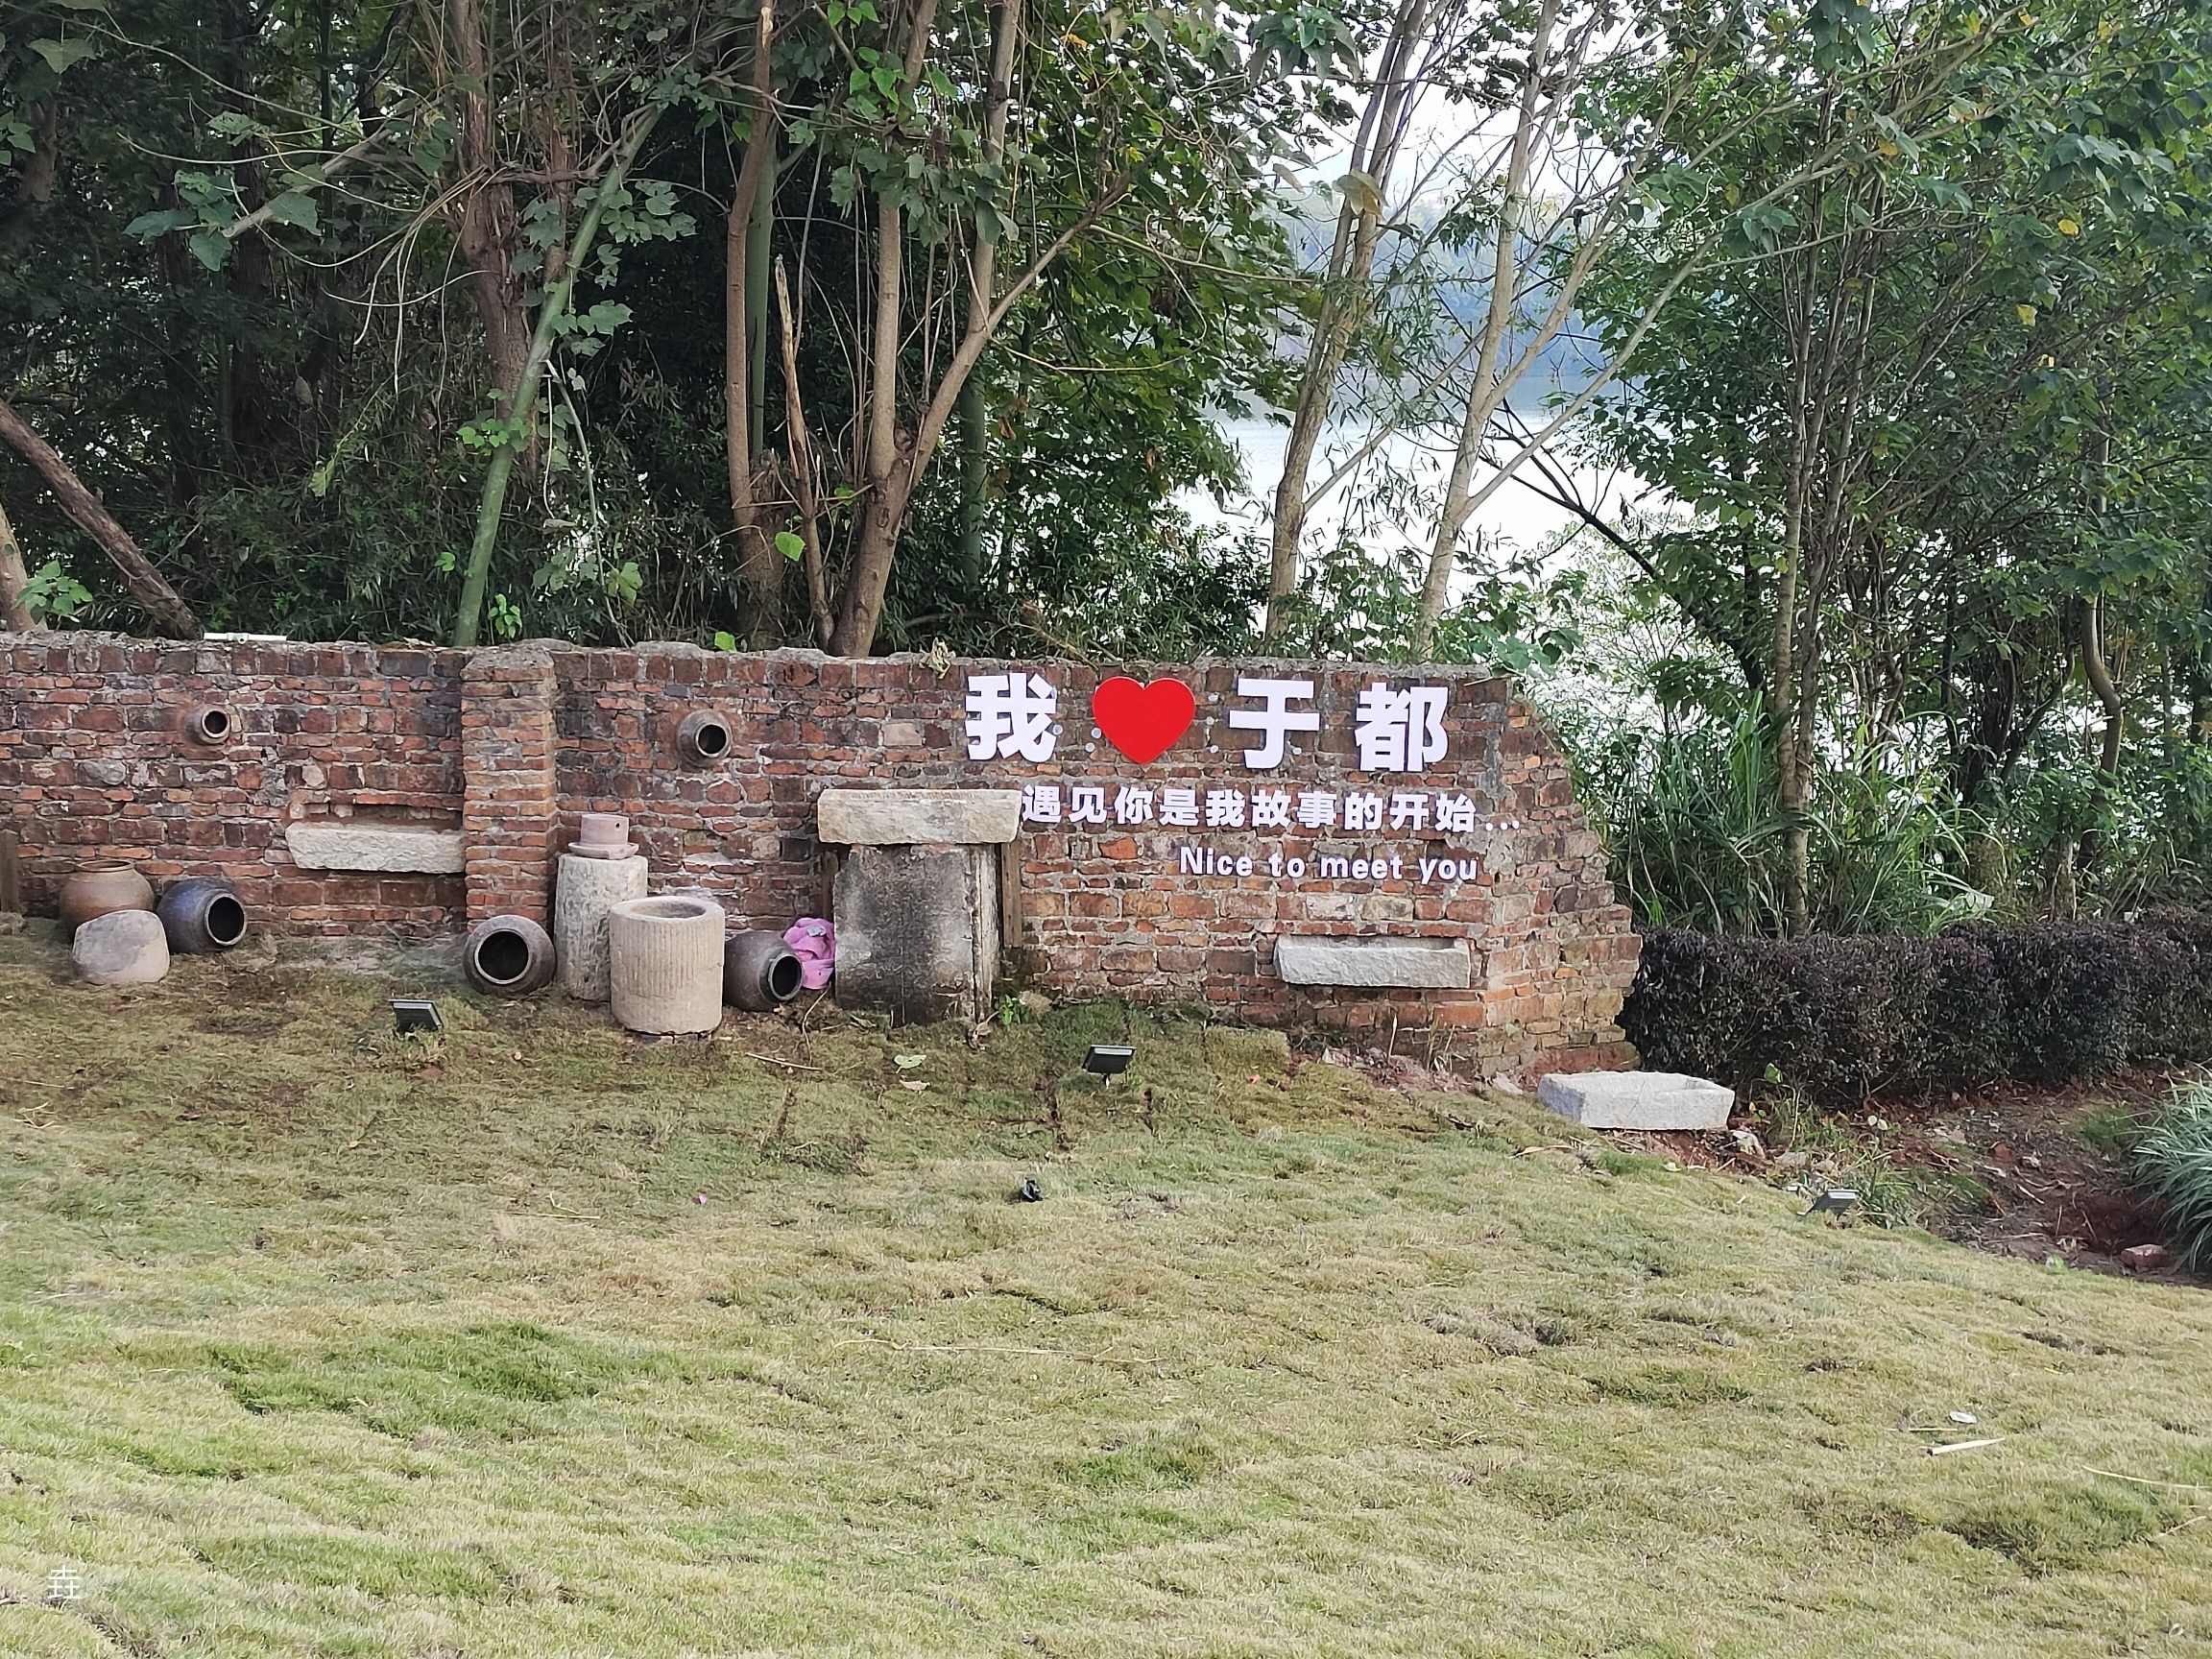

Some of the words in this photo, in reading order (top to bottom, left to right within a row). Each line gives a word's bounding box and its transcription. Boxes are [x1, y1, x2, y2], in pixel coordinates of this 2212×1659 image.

[965, 672, 1057, 763] 我
[1228, 678, 1450, 773] 于都
[1179, 846, 1254, 877] Nice
[1267, 852, 1306, 878] to
[1319, 854, 1404, 880] meet
[1418, 856, 1478, 885] you
